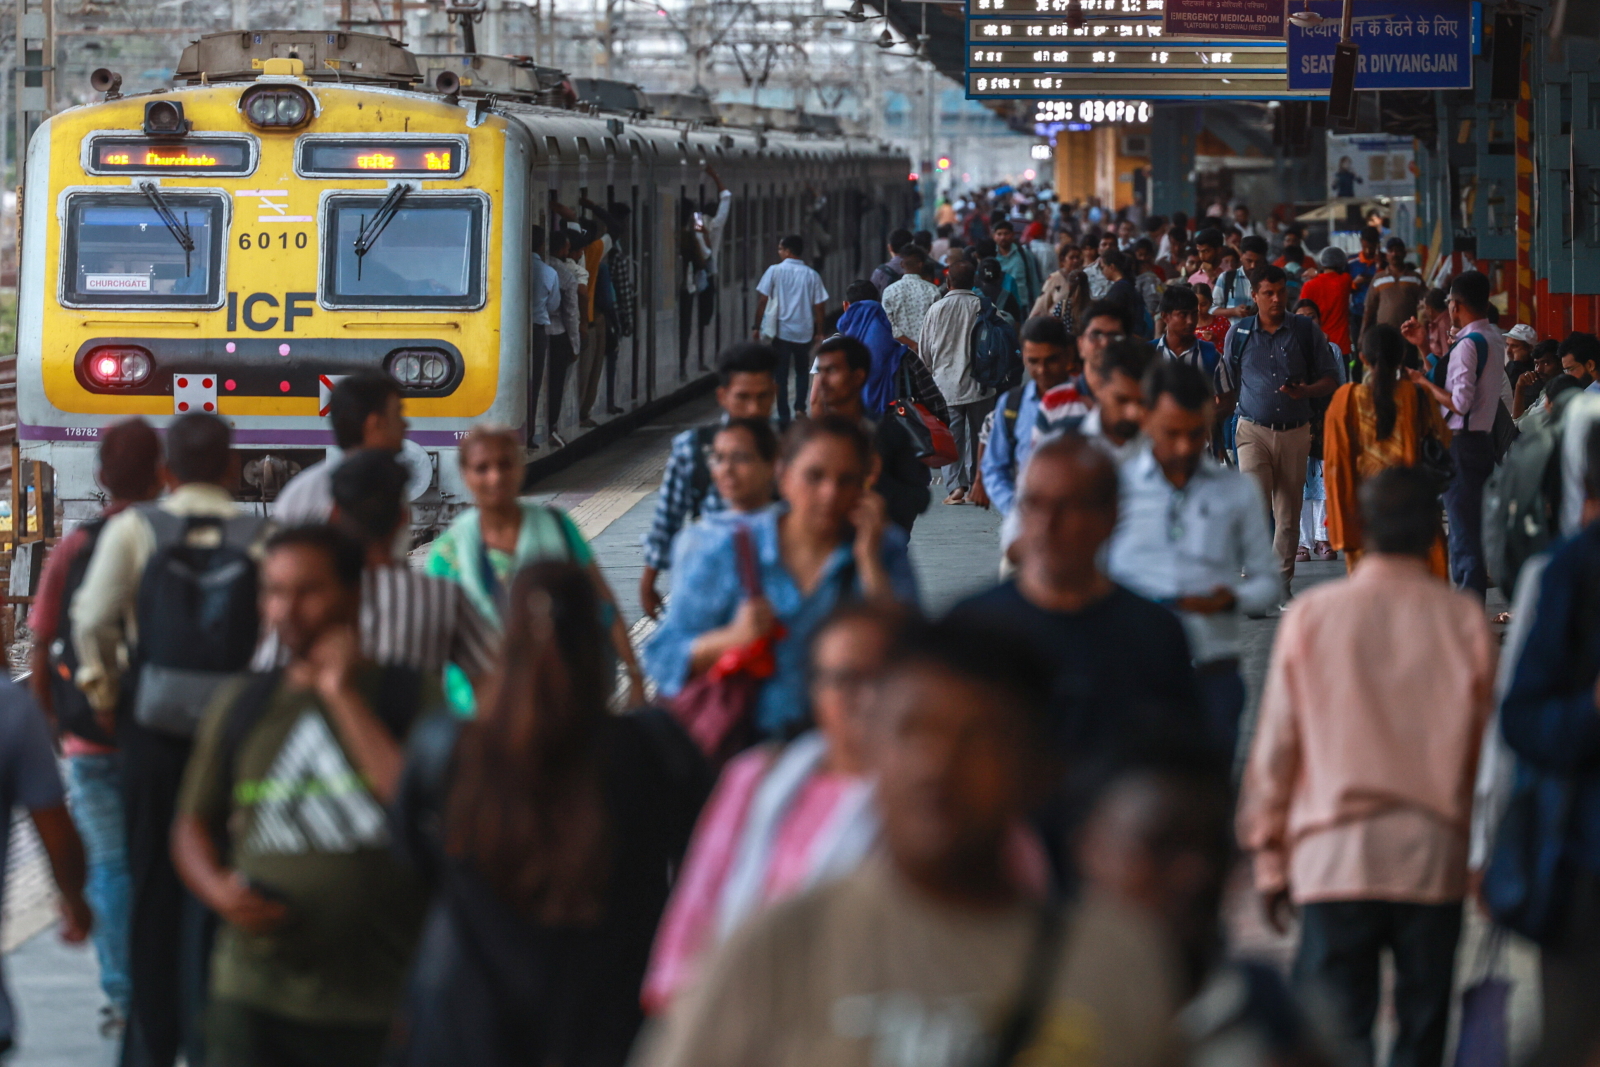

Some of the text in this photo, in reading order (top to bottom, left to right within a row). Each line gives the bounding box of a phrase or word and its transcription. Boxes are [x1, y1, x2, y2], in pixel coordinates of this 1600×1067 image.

[1170, 12, 1280, 24] EMERGENCY MEDICAL ROOM
[1368, 18, 1381, 37] के
[1385, 14, 1413, 37] बैठने
[1417, 14, 1430, 36] के
[1434, 14, 1458, 39] लिए
[1301, 54, 1336, 74] SEAT
[1371, 54, 1458, 73] DIVYANGJAN
[146, 153, 216, 165] Churchgate
[238, 232, 308, 250] 6010
[89, 280, 147, 288] CHURCHGATE
[226, 292, 317, 332] ICF
[65, 427, 98, 437] 178782
